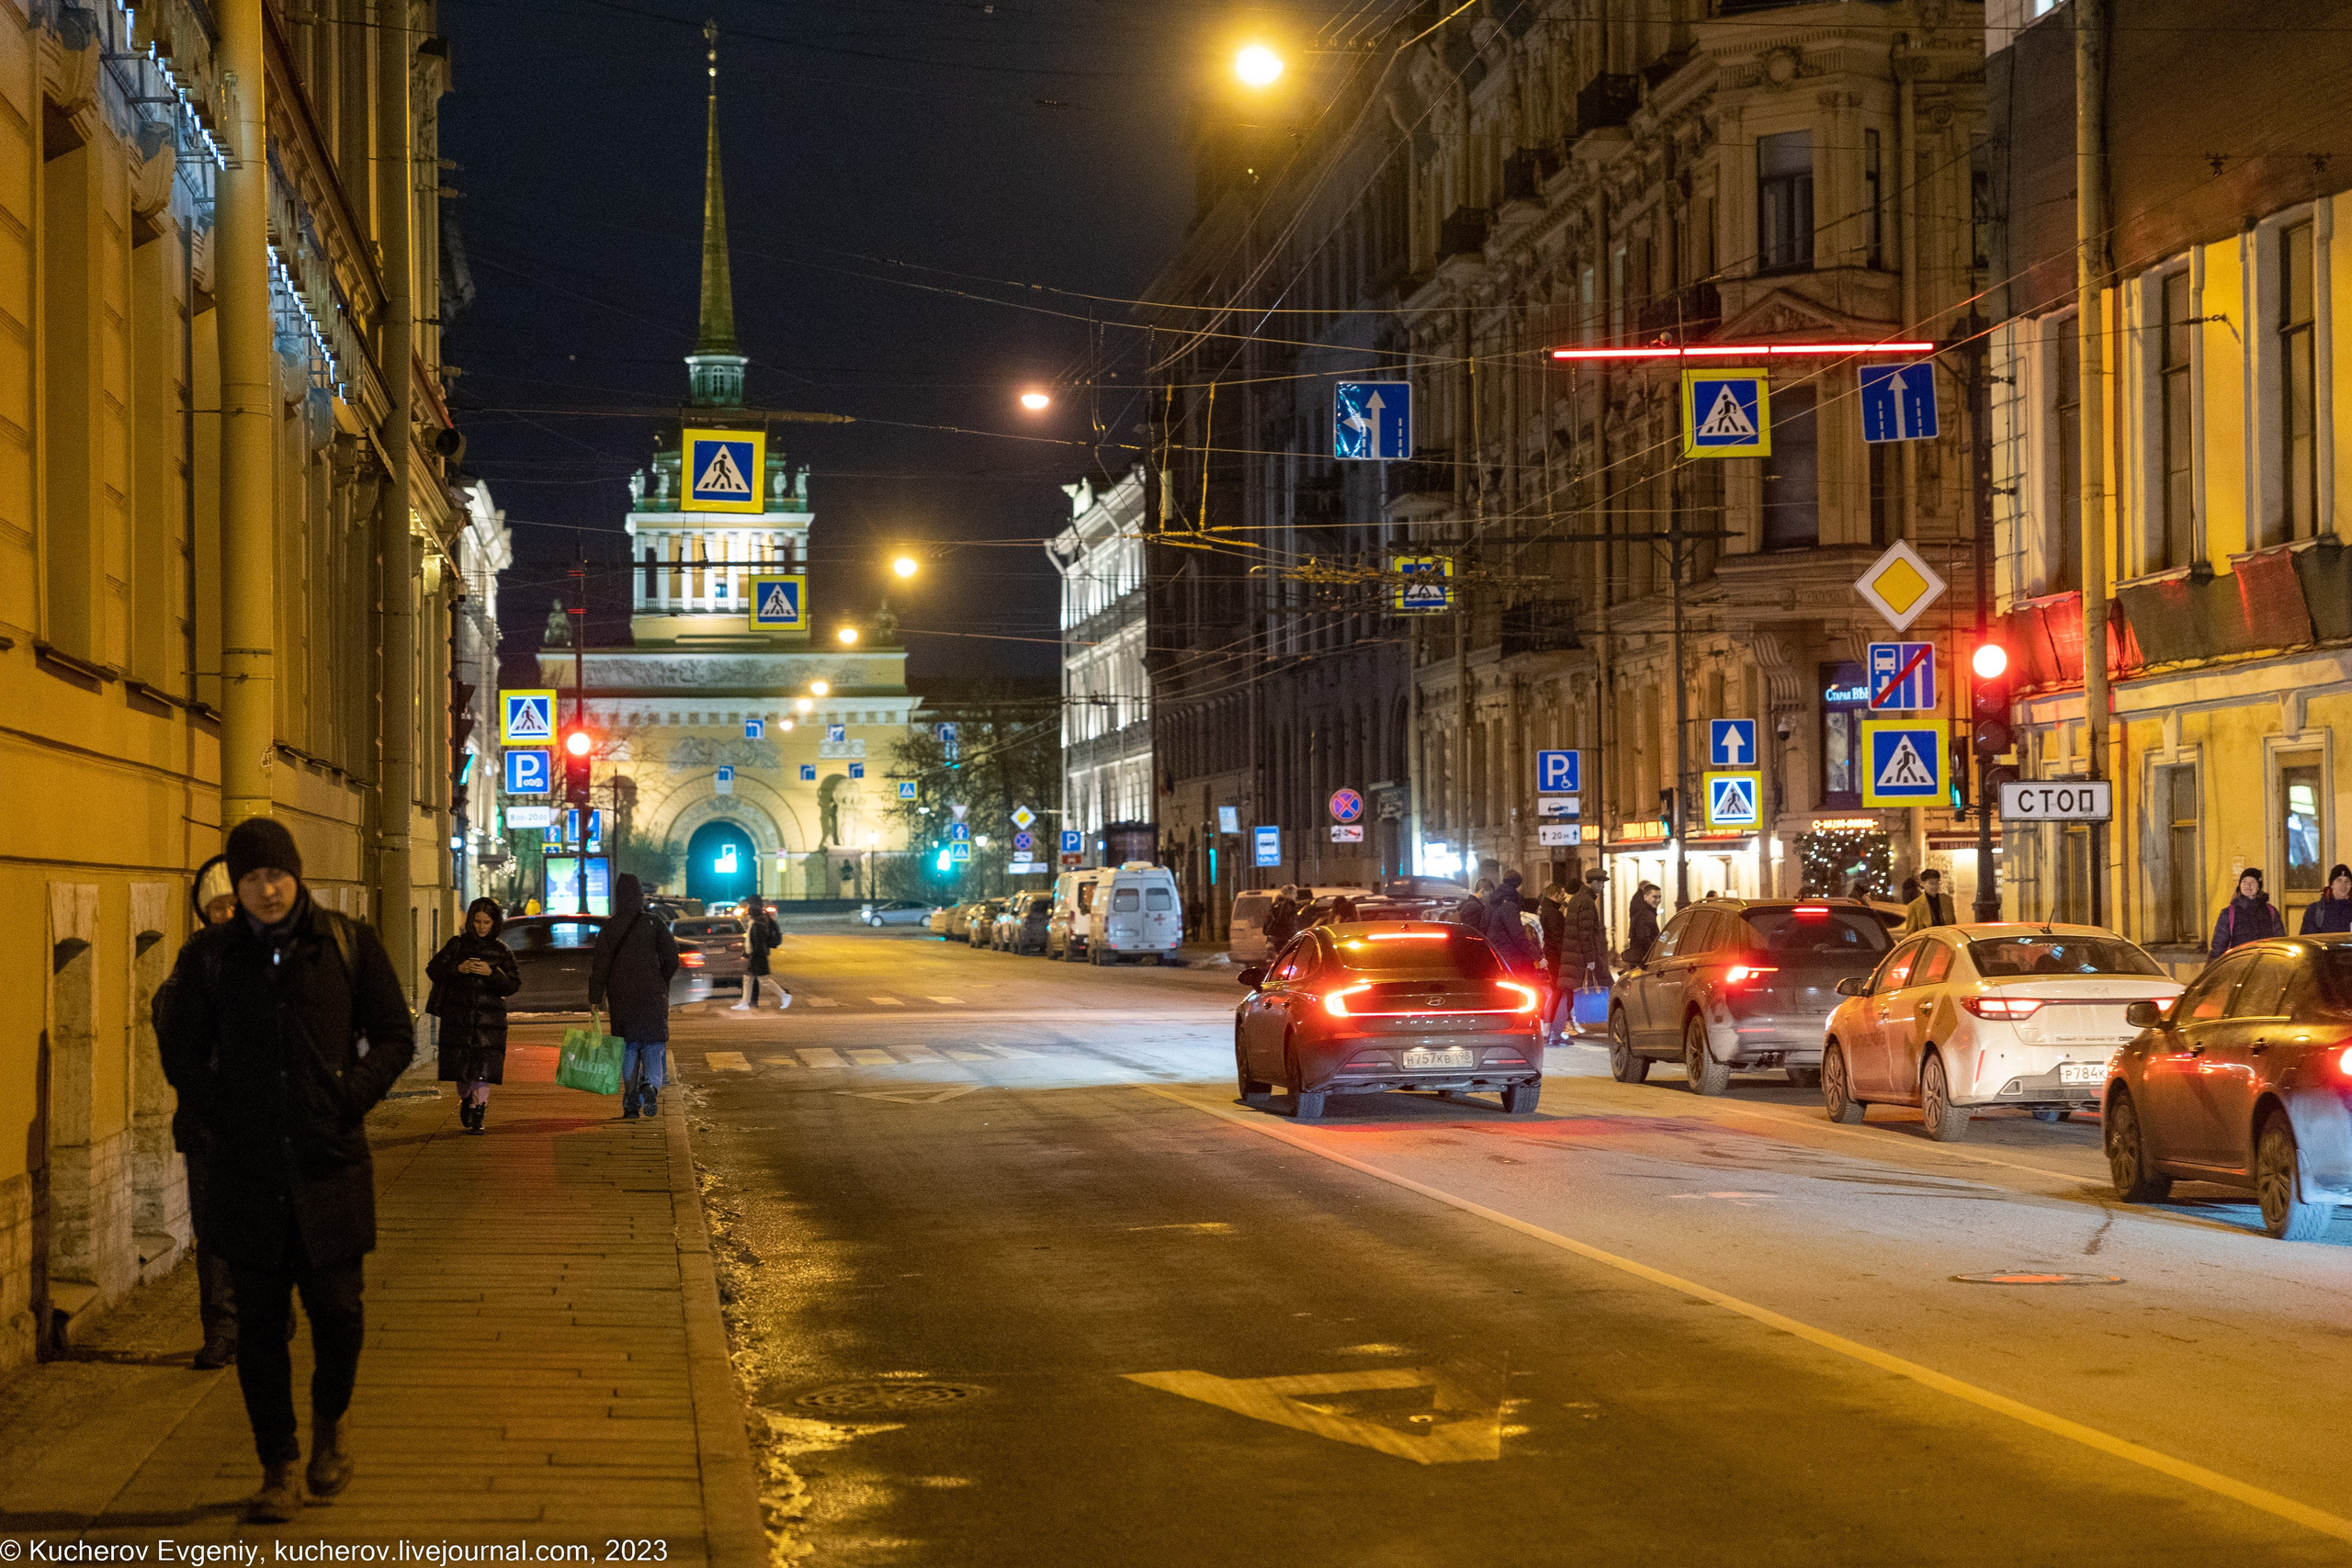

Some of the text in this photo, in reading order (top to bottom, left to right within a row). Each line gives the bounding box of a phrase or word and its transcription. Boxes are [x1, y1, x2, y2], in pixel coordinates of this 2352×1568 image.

[516, 755, 539, 788] P
[1547, 755, 1569, 786] P
[2018, 789, 2094, 812] СТОП
[1067, 833, 1079, 849] P
[1552, 831, 1562, 840] 20
